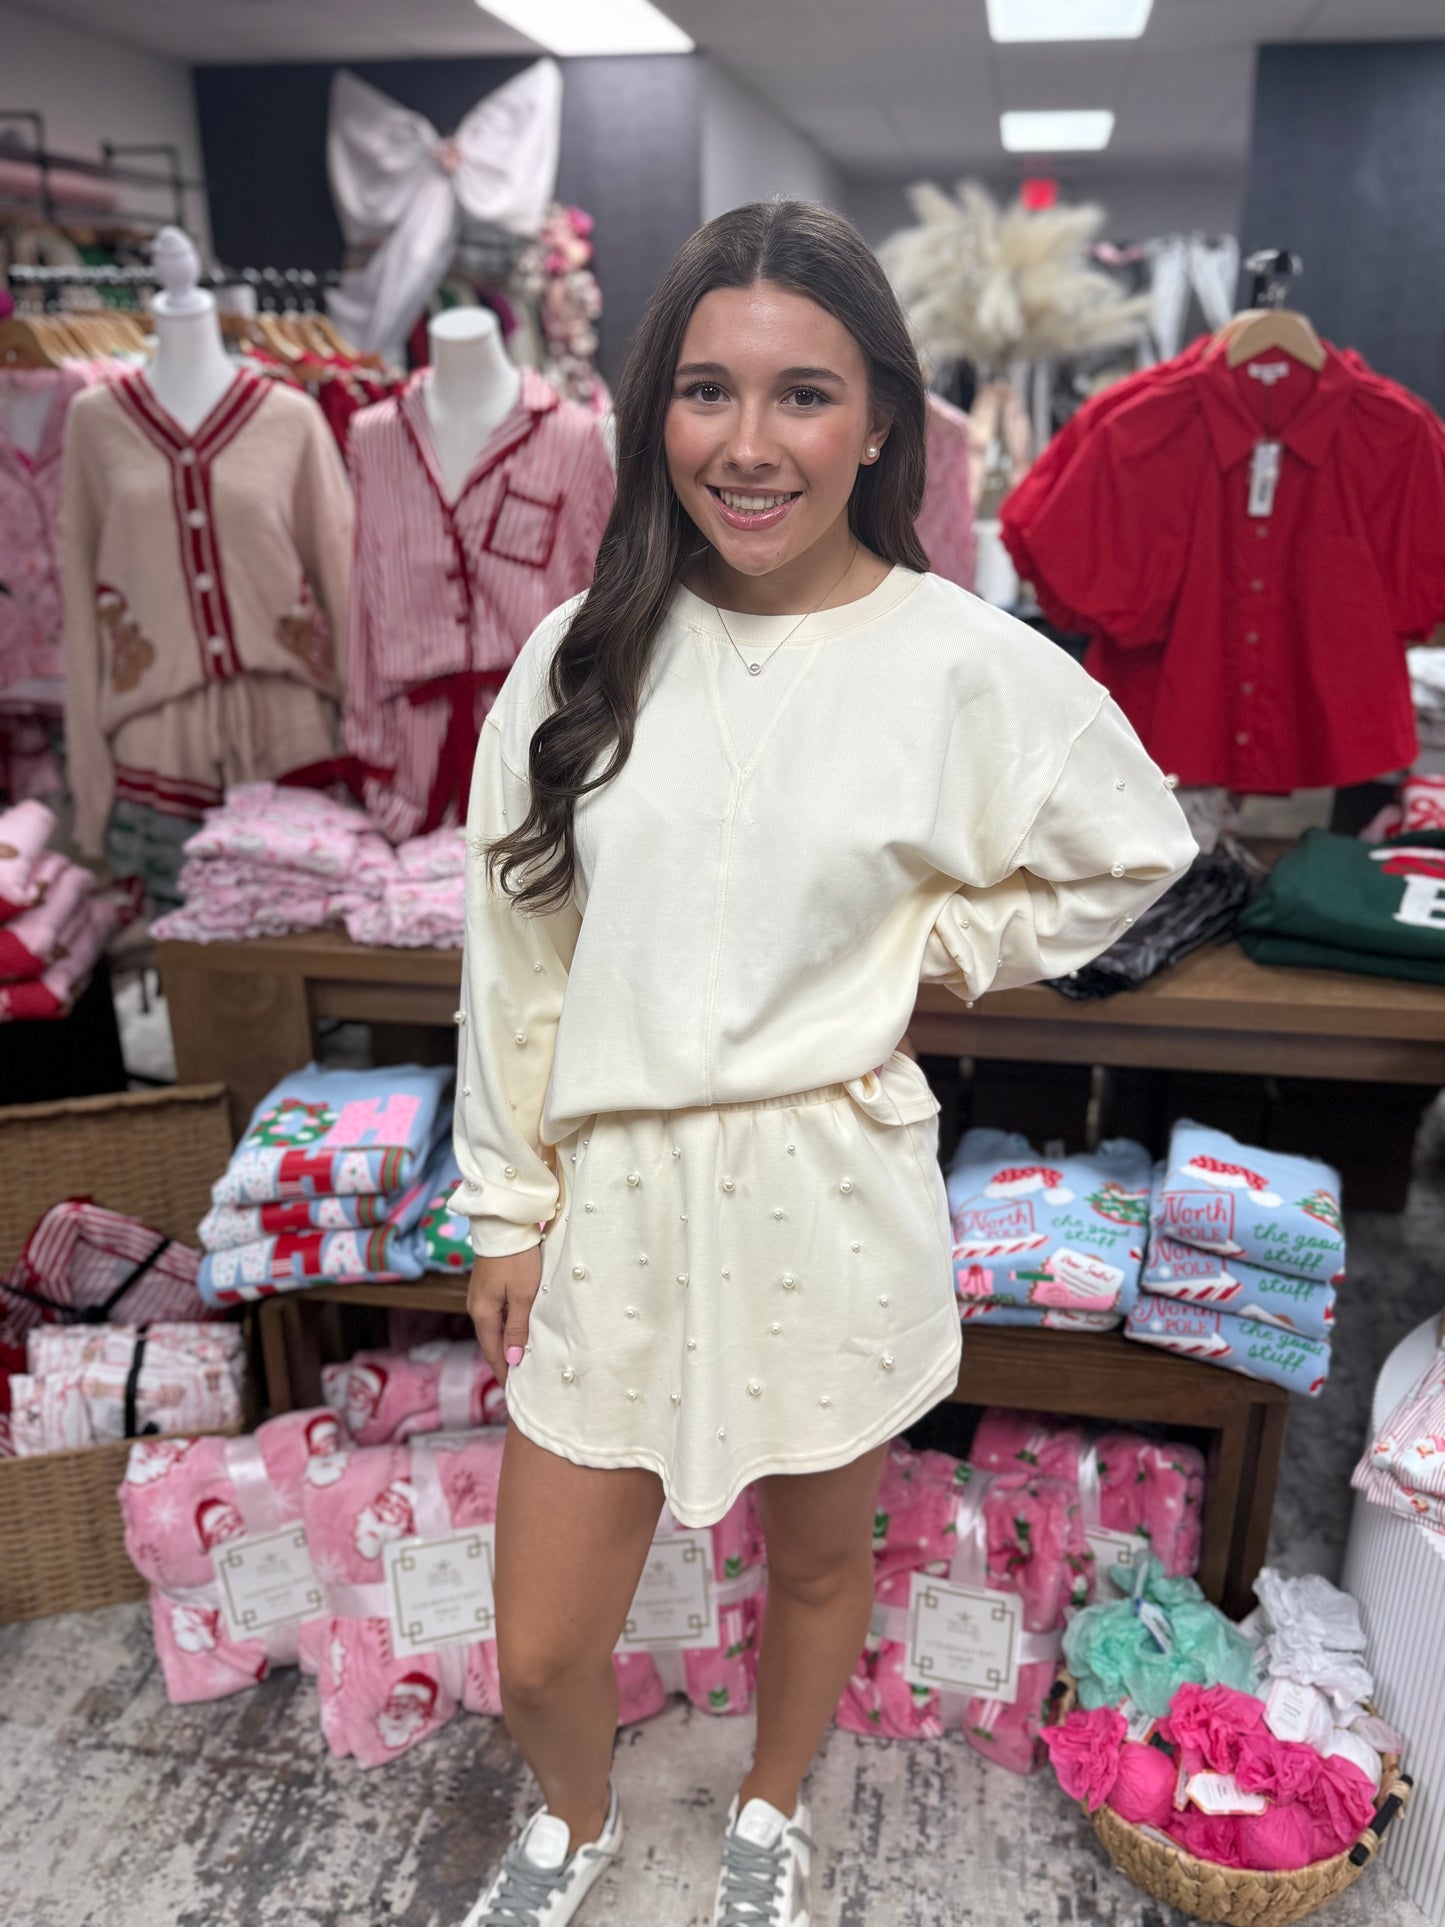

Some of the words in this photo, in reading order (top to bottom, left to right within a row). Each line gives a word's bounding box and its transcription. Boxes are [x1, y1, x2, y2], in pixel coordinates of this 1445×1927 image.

[1151, 1196, 1228, 1226] North
[1252, 1222, 1289, 1244] the
[1291, 1233, 1343, 1253] good
[1172, 1260, 1216, 1279] POLE
[1263, 1247, 1325, 1274] stuff
[1257, 1276, 1314, 1301] stuff
[1165, 1317, 1209, 1336] POLE
[1247, 1341, 1308, 1373] stuff
[1275, 1335, 1325, 1356] good
